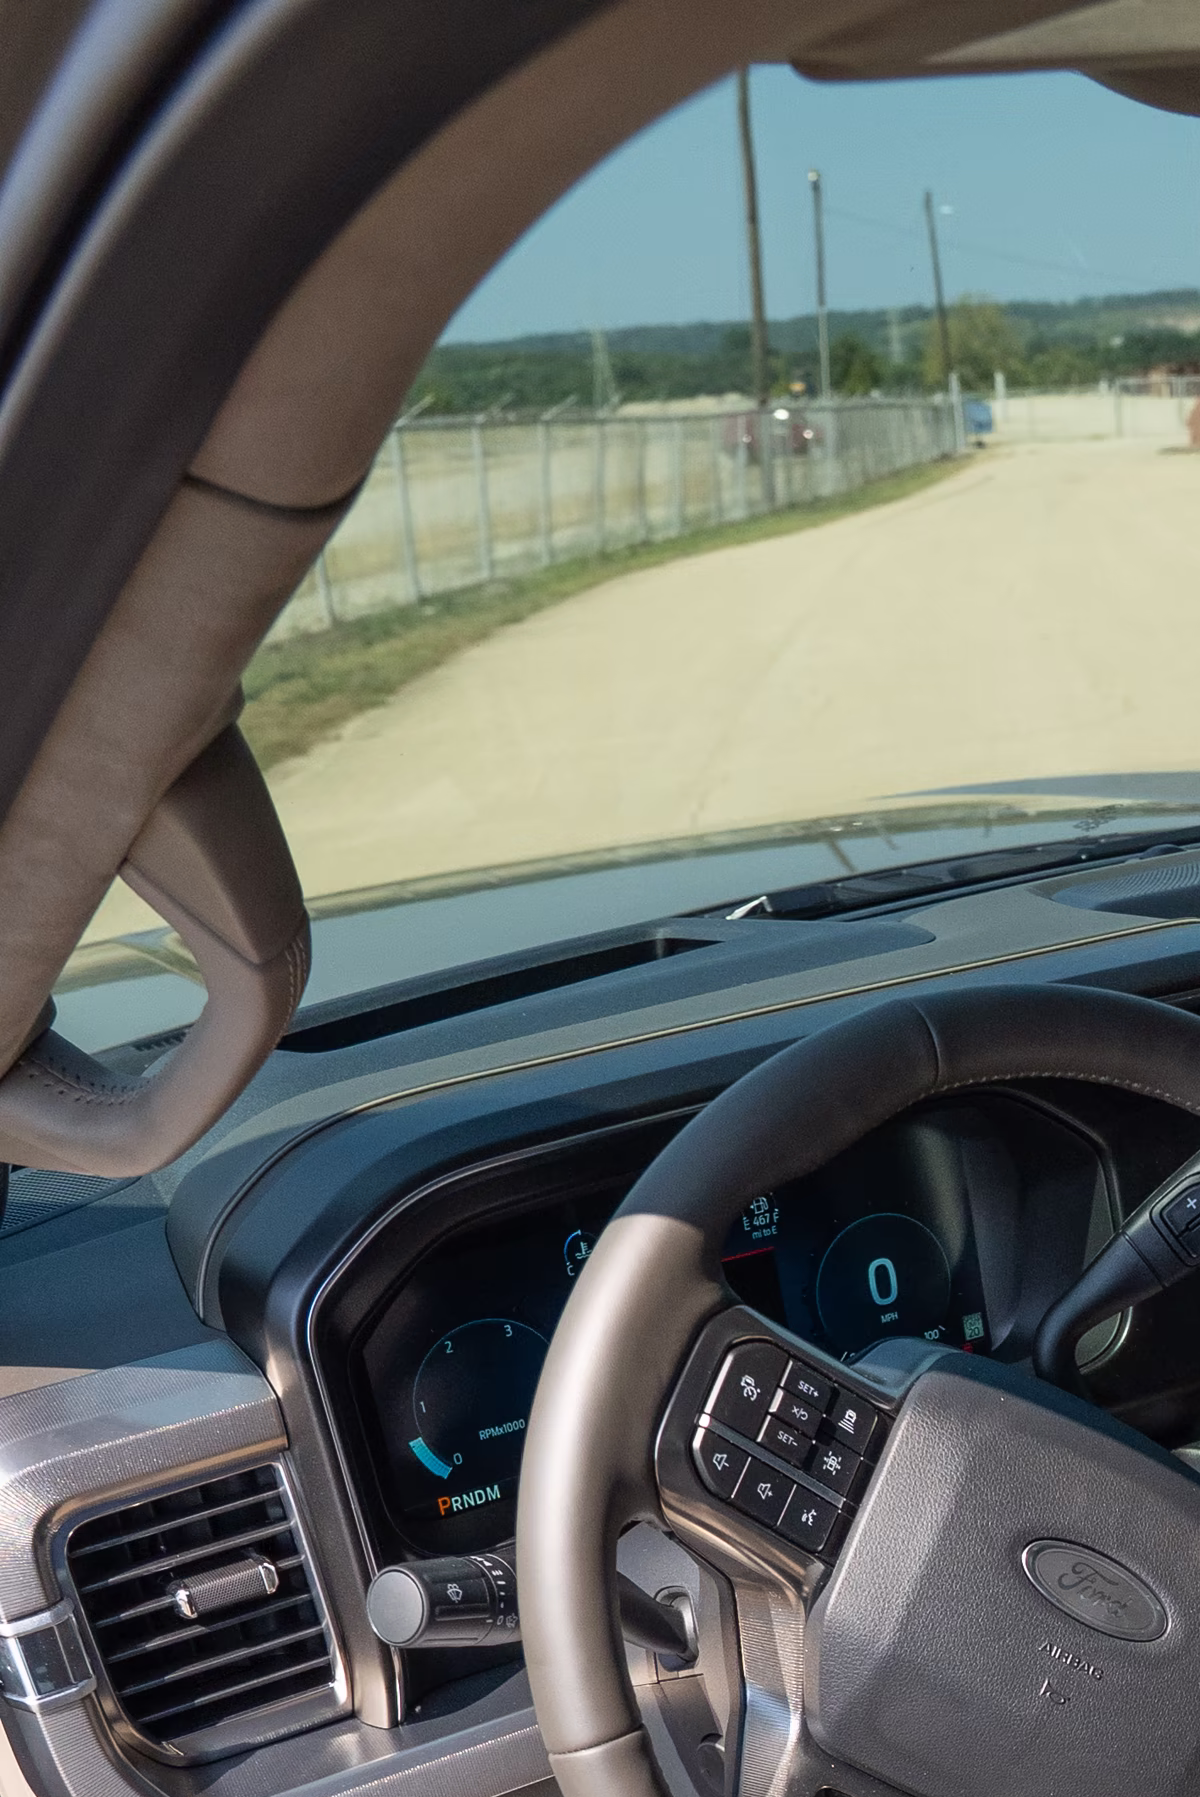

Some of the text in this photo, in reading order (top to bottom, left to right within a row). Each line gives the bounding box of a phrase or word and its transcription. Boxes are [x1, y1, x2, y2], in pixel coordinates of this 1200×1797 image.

[753, 1213, 770, 1227] 467
[763, 1227, 771, 1237] to
[868, 1257, 898, 1306] 0
[881, 1312, 899, 1324] MPH
[504, 1324, 513, 1337] 3
[444, 1341, 453, 1353] 2
[420, 1401, 426, 1413] 1
[479, 1418, 526, 1441] RPMx1000
[453, 1453, 463, 1465] 0
[1039, 1641, 1104, 1680] AIRBAG
